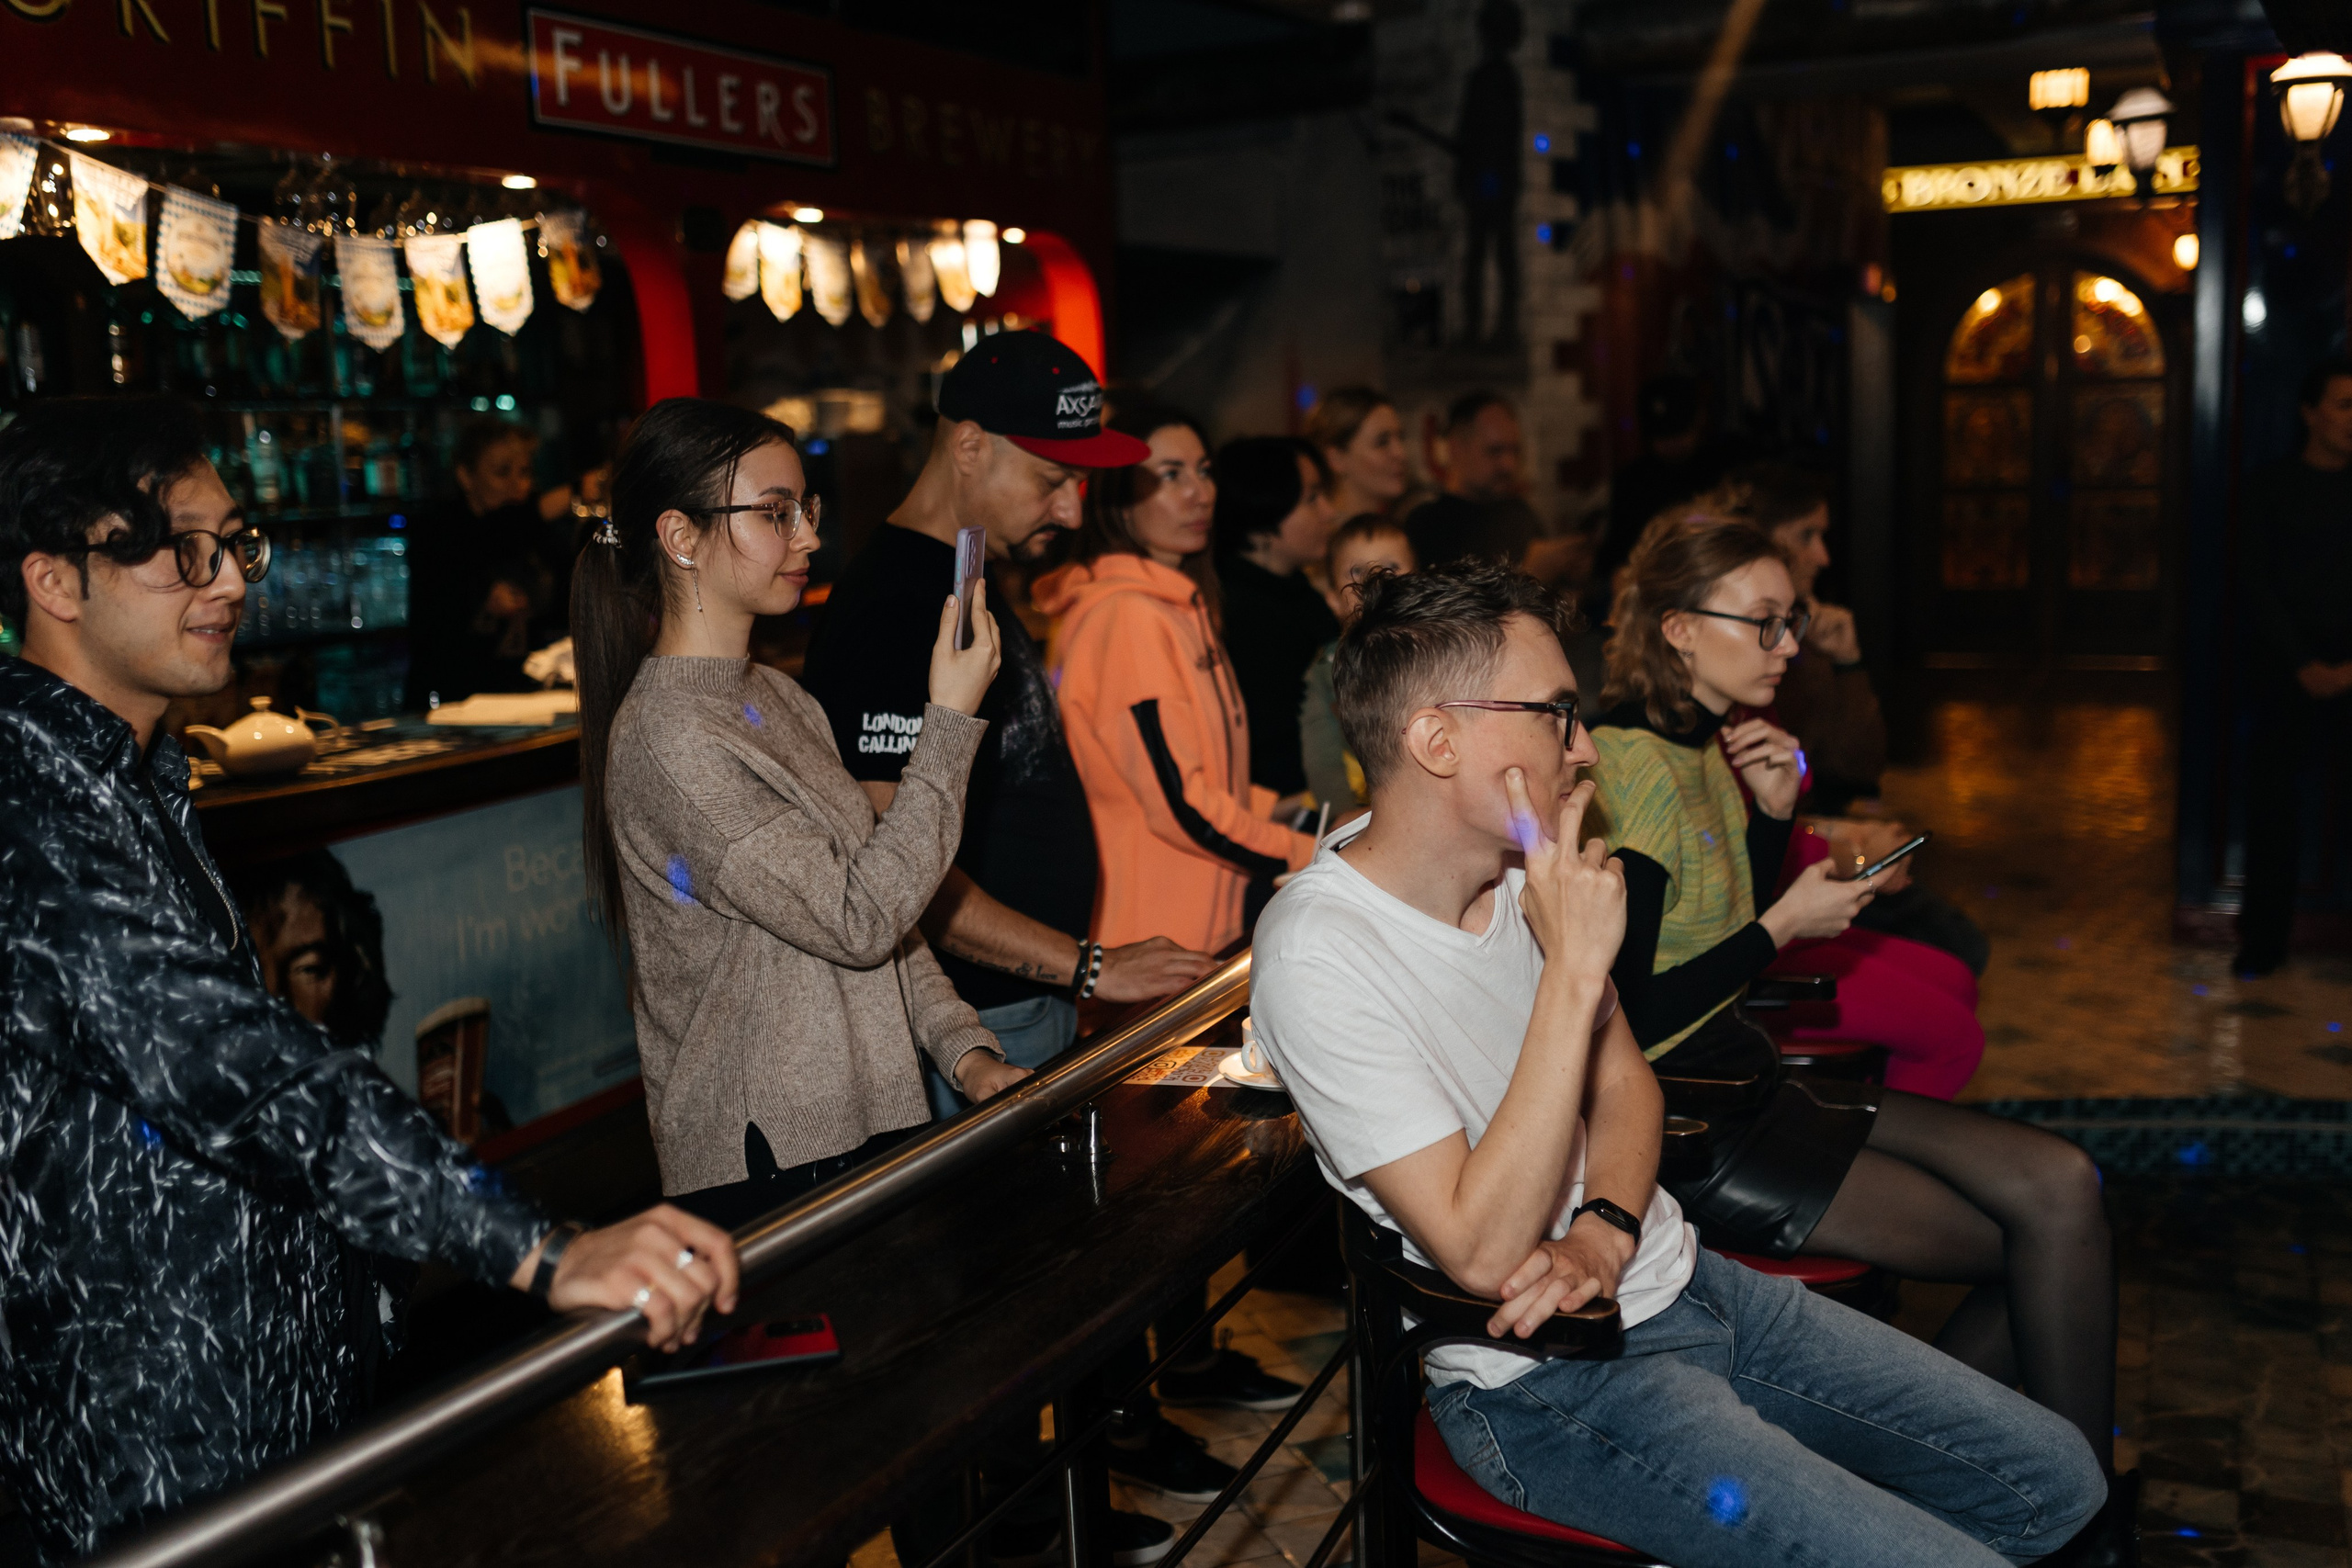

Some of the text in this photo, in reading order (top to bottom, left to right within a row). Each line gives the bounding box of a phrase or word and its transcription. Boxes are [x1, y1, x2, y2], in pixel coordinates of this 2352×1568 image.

[552, 26, 820, 149] FULLERS
[857, 733, 920, 755] CALLIN
[503, 840, 584, 893] Beca
